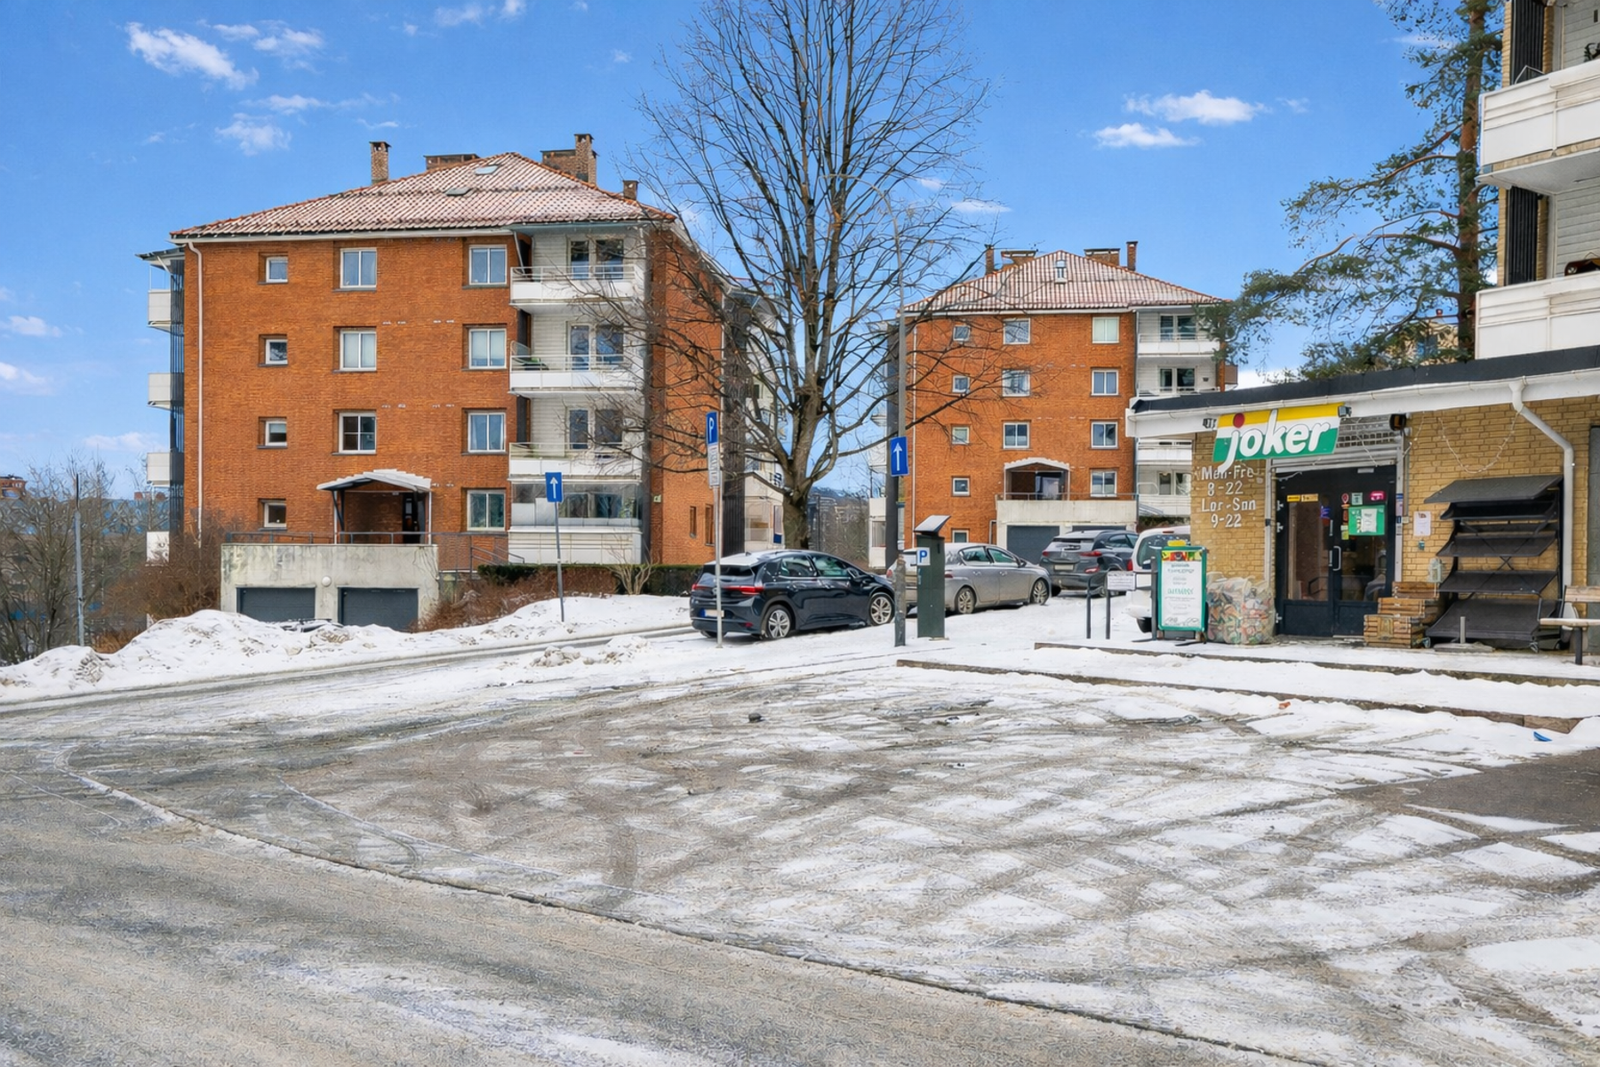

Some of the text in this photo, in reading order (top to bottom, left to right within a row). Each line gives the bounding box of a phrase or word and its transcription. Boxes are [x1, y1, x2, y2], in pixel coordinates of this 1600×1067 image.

[708, 416, 715, 442] P
[1218, 408, 1331, 474] joker
[919, 549, 928, 563] P
